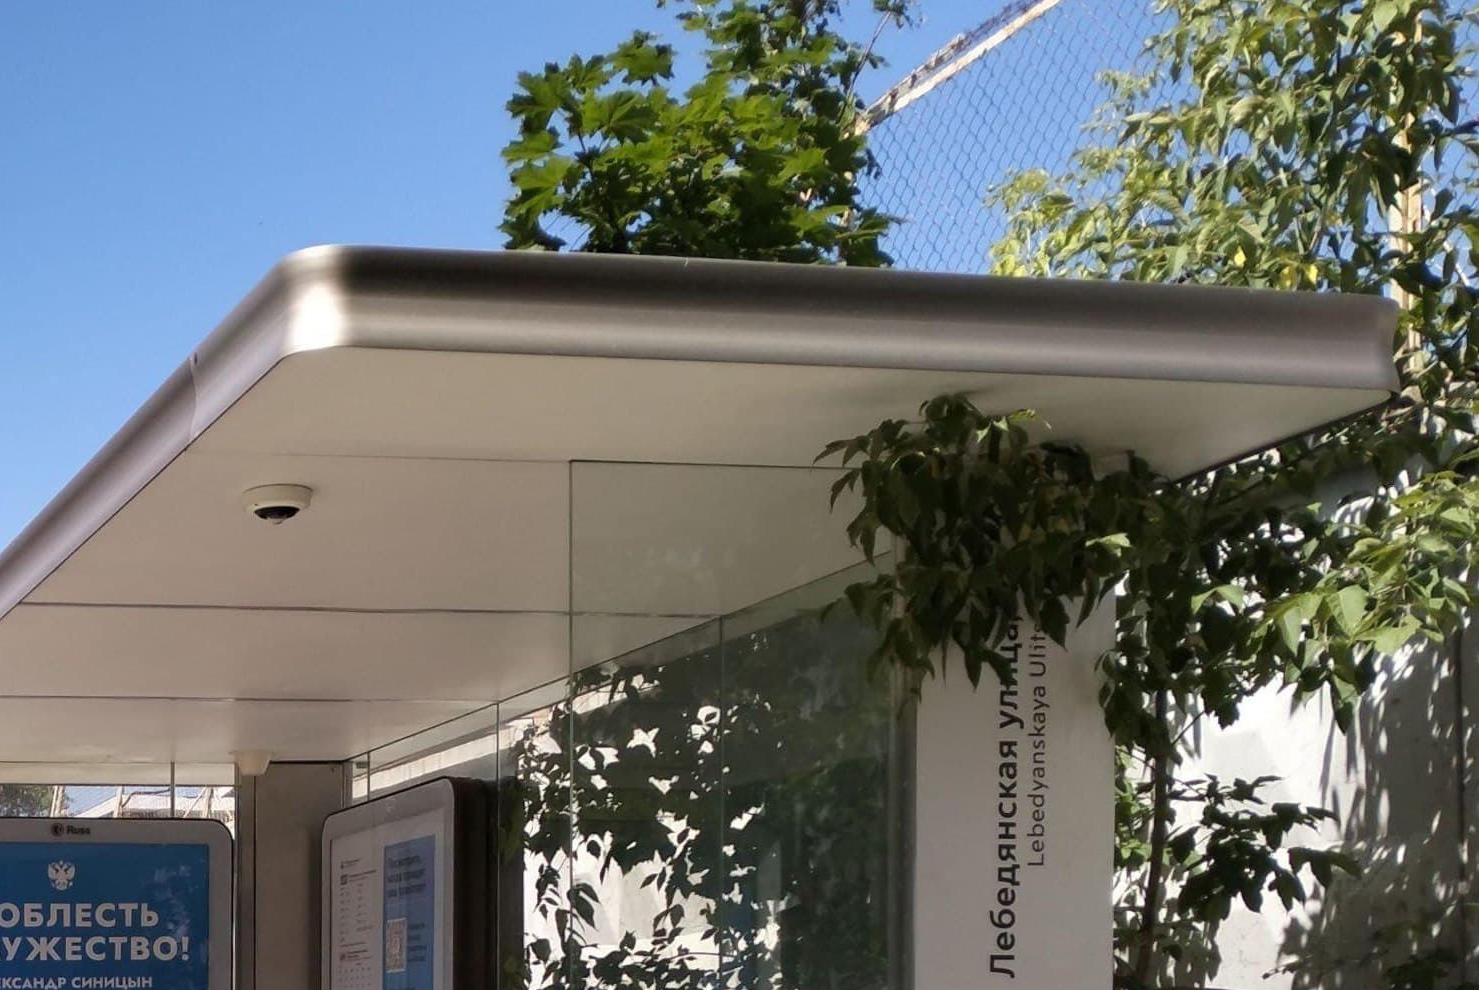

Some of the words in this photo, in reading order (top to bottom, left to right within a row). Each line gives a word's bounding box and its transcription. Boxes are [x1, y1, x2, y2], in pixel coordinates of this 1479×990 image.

[989, 740, 1021, 979] Лебедянская
[1027, 685, 1050, 867] Lebedyanskaya
[71, 976, 153, 989] СИНИЦЫН
